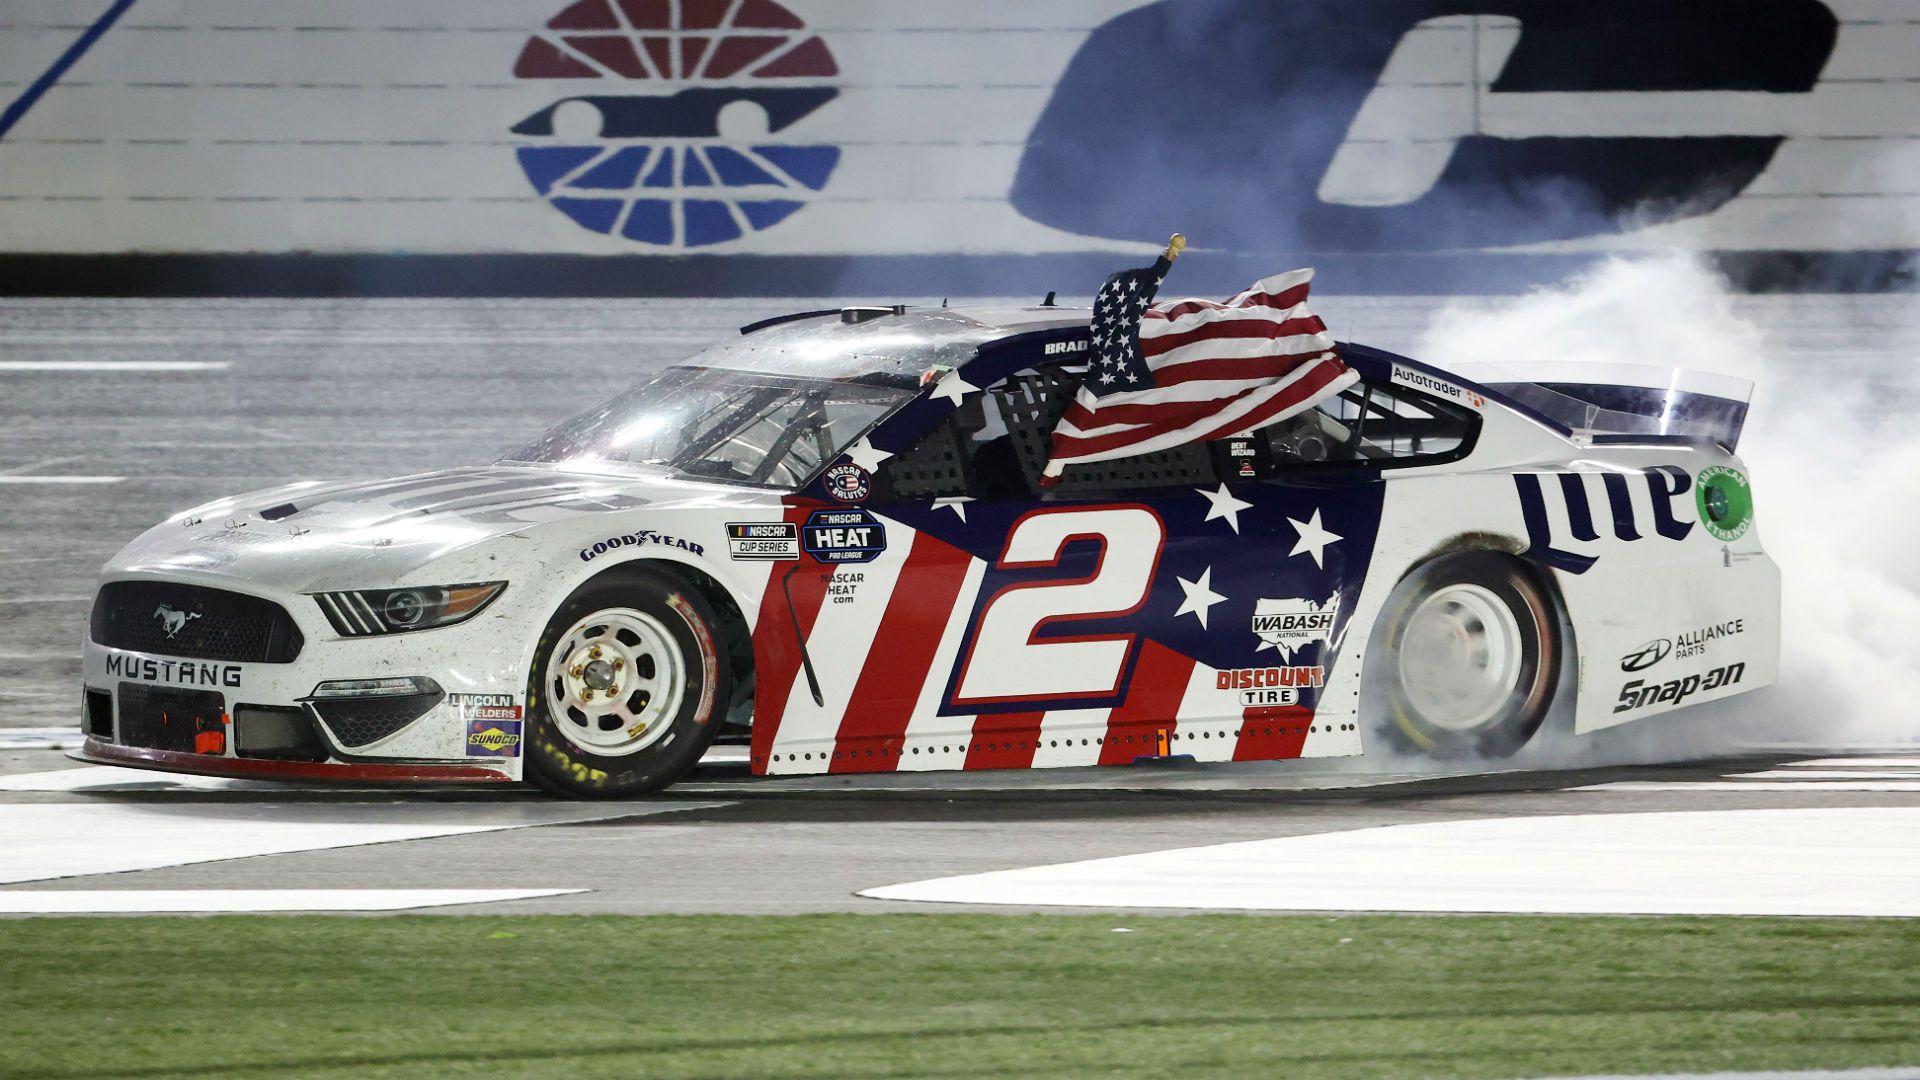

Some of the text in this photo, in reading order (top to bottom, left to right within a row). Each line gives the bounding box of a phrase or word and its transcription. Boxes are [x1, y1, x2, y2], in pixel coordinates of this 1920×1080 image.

[1045, 340, 1088, 354] BRAD
[1394, 367, 1461, 397] Autotrader
[827, 466, 861, 480] NASCAR
[1698, 466, 1748, 489] AMERICAN
[832, 486, 867, 499] SALUTES
[828, 514, 862, 524] NASCAR
[750, 526, 787, 537] NASCAR
[1705, 517, 1750, 540] ETHANOL
[815, 528, 871, 548] HEAT
[740, 542, 789, 552] CUP SERIES
[821, 573, 864, 583] NASCAR
[828, 585, 857, 595] HEAT
[951, 503, 1166, 705] 2
[1253, 615, 1334, 631] WABASH
[1676, 619, 1743, 649] ALLIANCE
[1676, 644, 1705, 660] PARTS
[106, 653, 243, 687] MUSTANG
[1216, 666, 1324, 690] DISCOUNT
[1613, 662, 1745, 713] Snap-on
[452, 695, 511, 706] LINCOLN
[1245, 691, 1291, 704] TIRE
[464, 708, 516, 718] WELDERS
[470, 734, 517, 744] SUNOCO
